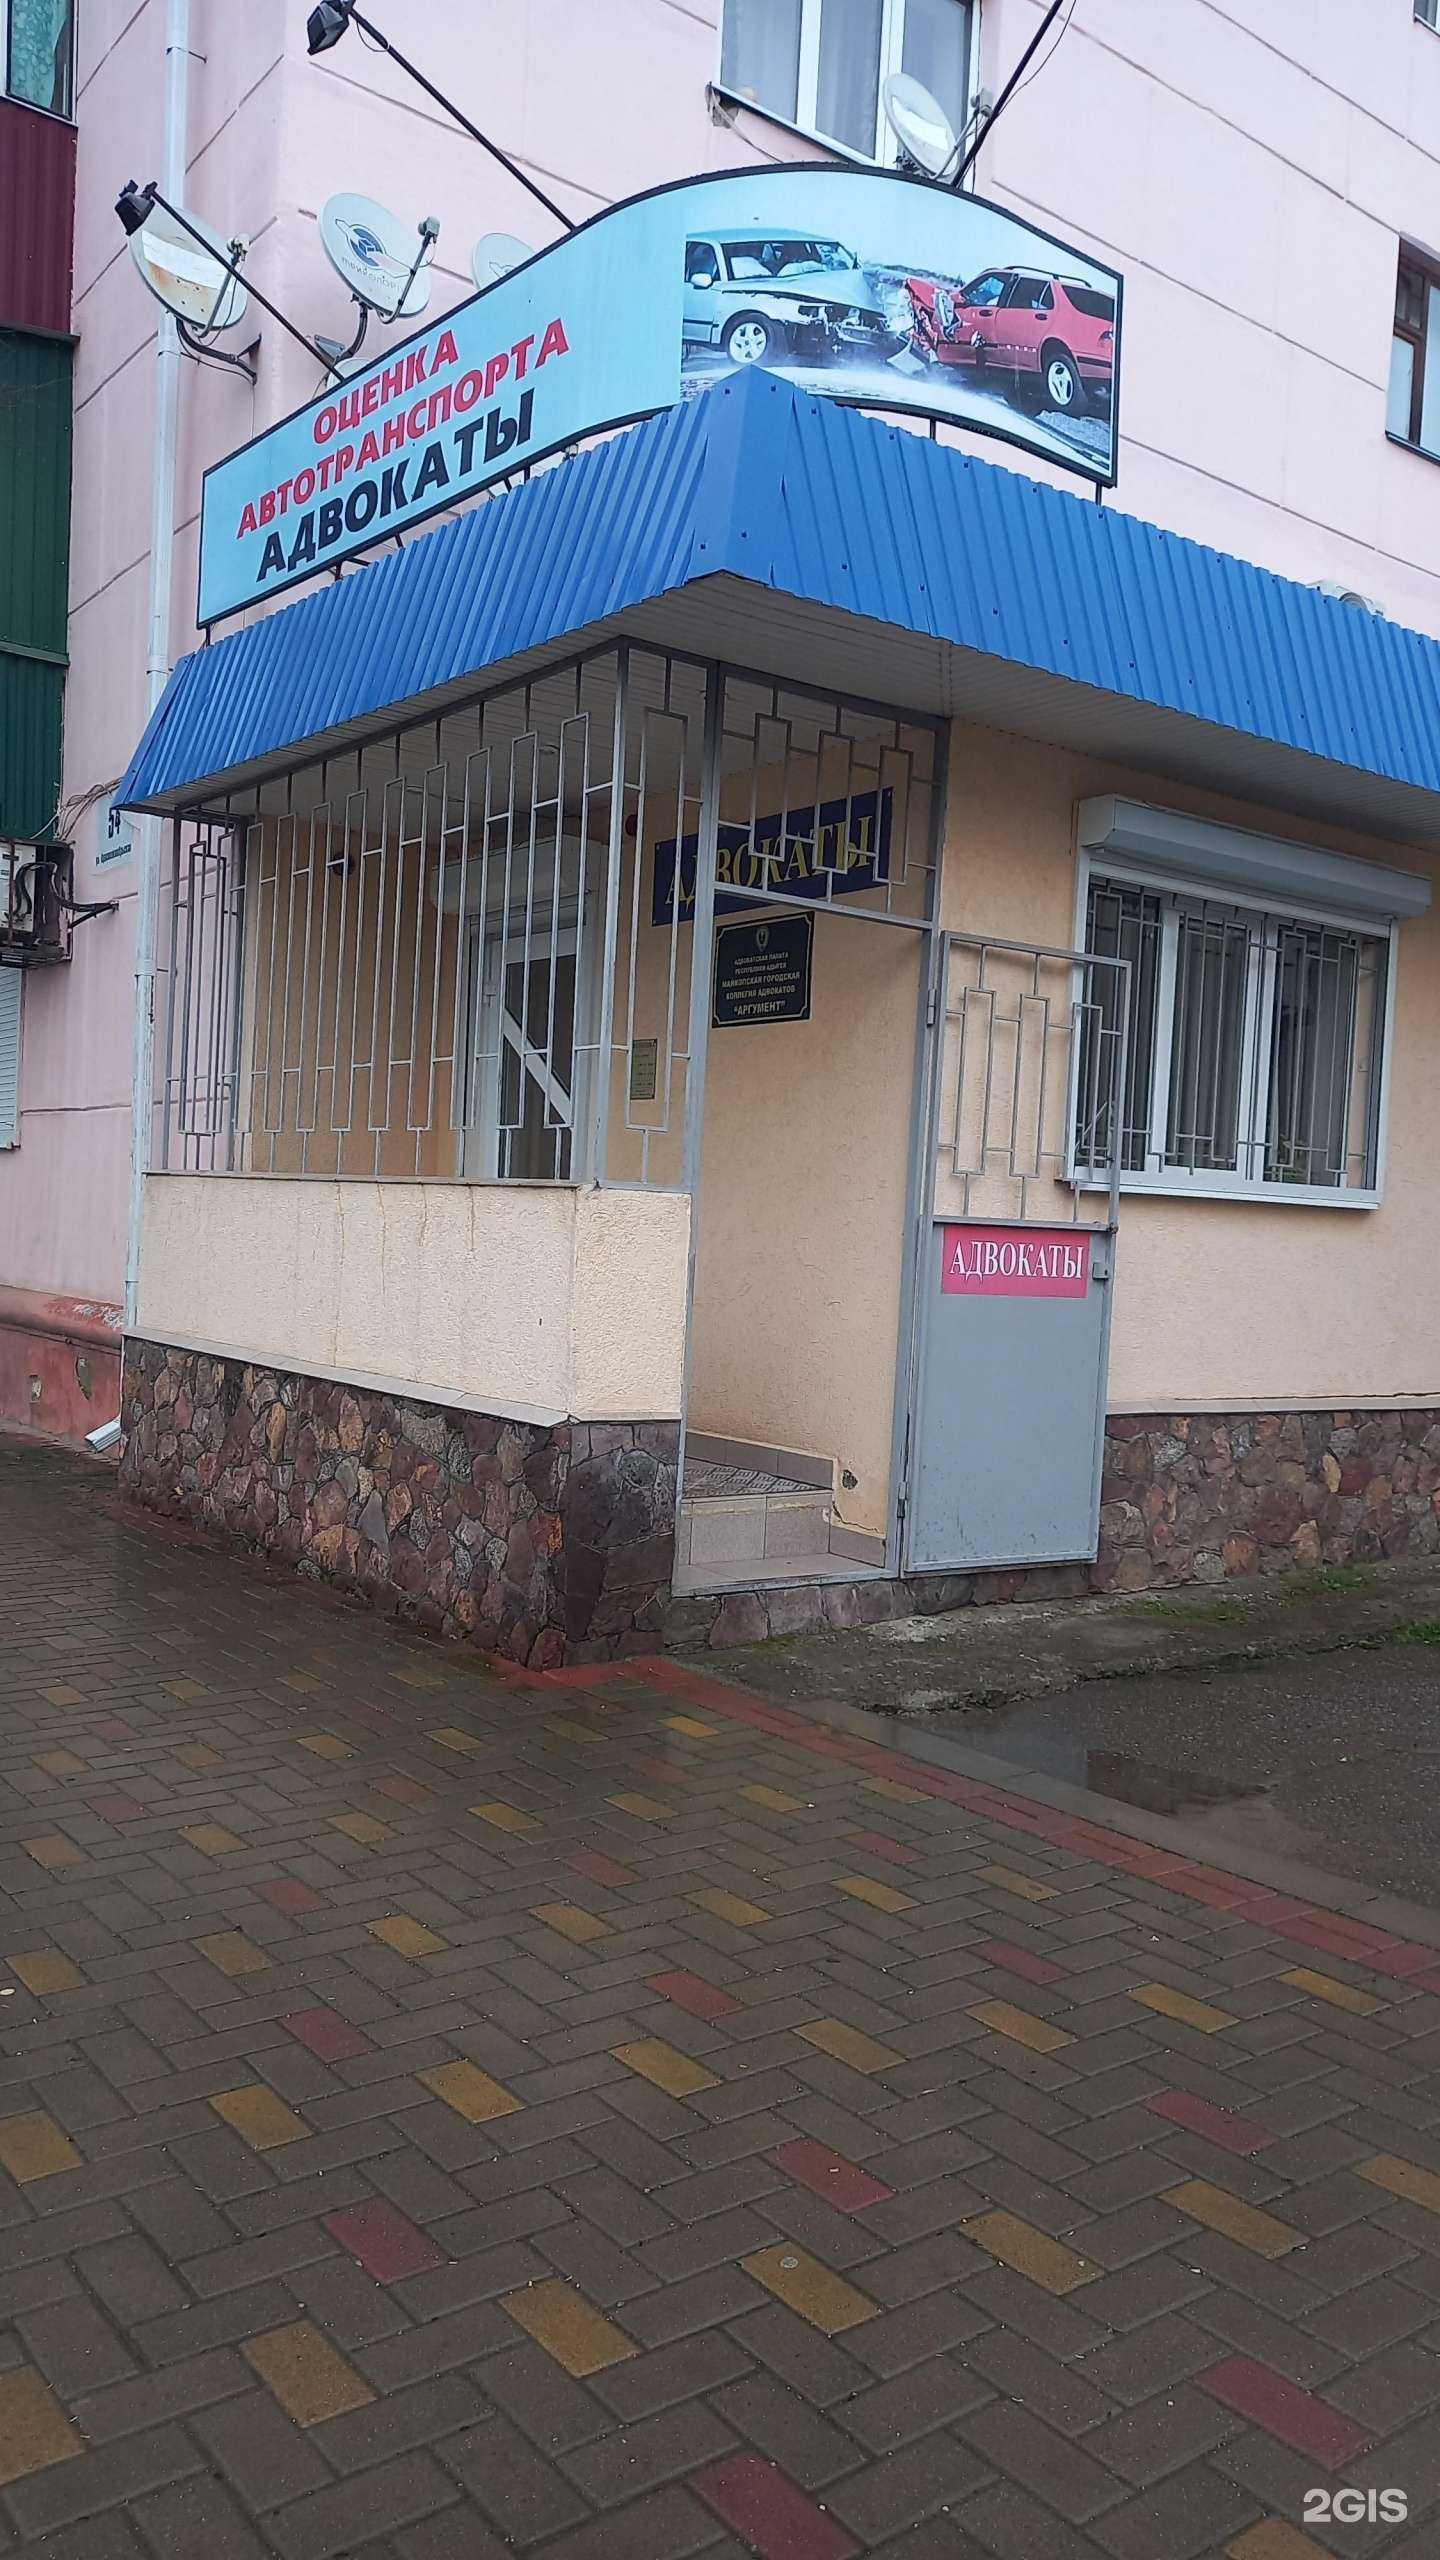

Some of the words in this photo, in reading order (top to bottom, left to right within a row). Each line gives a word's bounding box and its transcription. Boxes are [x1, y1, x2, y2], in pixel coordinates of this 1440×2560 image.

[313, 329, 458, 444] ОЦЕНКА
[236, 317, 570, 539] АВТОТРАНСПОРТА
[256, 387, 535, 583] АДВОКАТЫ
[721, 975, 762, 988] МАЙКОПСКАЯ
[763, 971, 800, 983] ГОРОДСКАЯ
[726, 990, 757, 1000] КОЛЛЕГИЯ
[758, 984, 796, 997] АДВОКАТОВ
[949, 1240, 1084, 1284] АДВОКАТЫ
